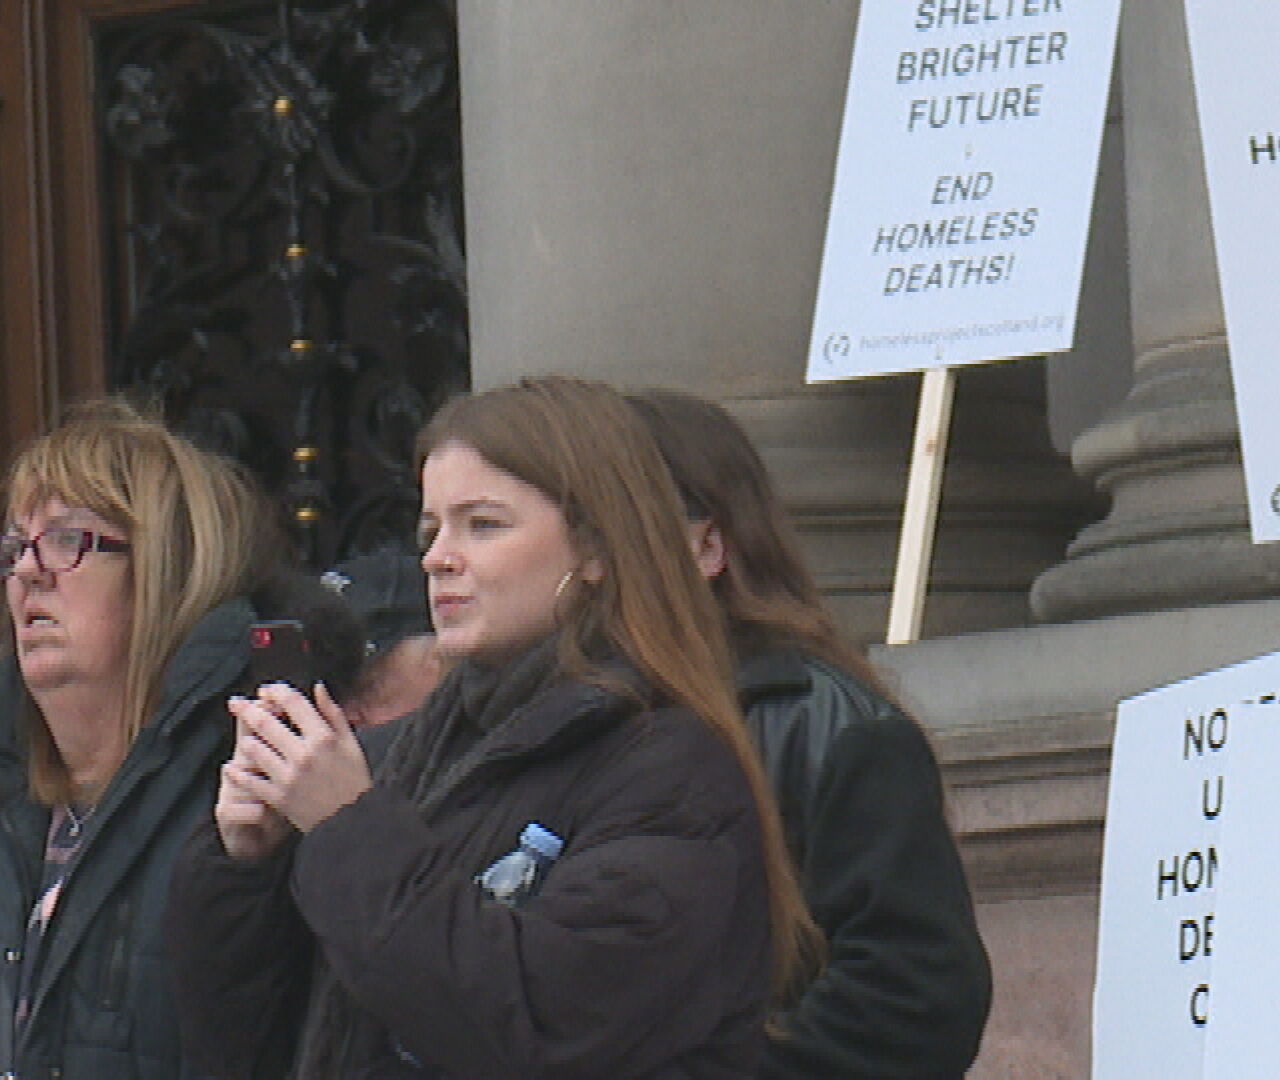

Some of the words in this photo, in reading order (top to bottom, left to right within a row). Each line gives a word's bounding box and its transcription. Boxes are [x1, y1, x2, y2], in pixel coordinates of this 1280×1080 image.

[896, 32, 1067, 85] BRIGHTER
[908, 82, 1042, 132] FUTURE
[932, 172, 993, 204] END
[873, 208, 1038, 256] HOMELESS
[883, 254, 1014, 297] DEATHS!
